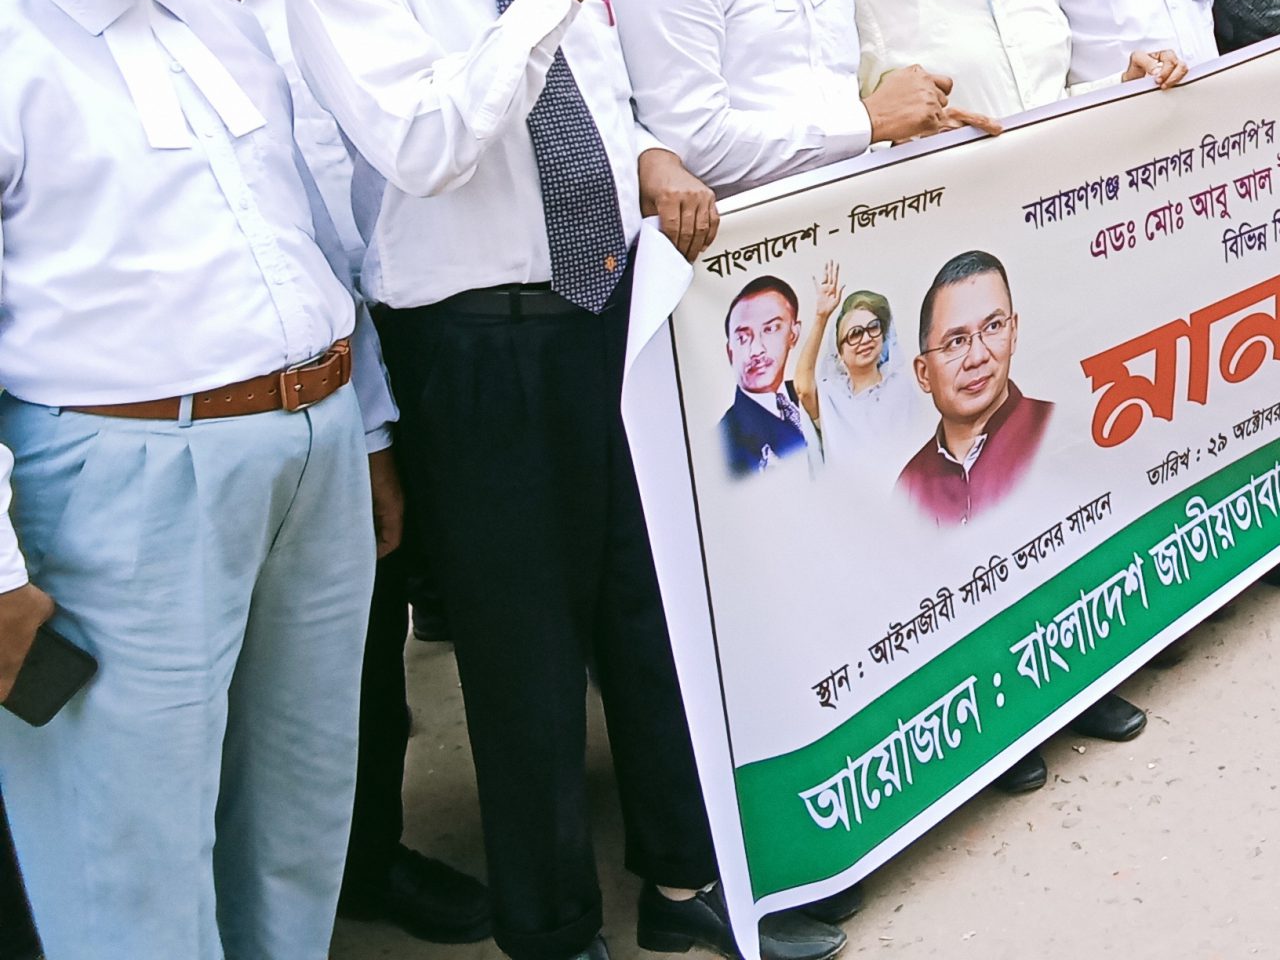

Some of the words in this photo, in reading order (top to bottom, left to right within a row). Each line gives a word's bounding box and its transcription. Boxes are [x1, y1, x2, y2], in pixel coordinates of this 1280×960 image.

[703, 222, 819, 279] বাংলাদেশ
[848, 183, 946, 236] জিন্দাবাদ
[1022, 174, 1120, 230] নারায়ণগঞ্জ
[1126, 147, 1195, 193] মহানগর
[1090, 219, 1137, 259] এডঃ
[1145, 200, 1185, 242] মোঃ
[1189, 182, 1232, 221] আবু
[1233, 166, 1273, 203] আল
[1221, 222, 1268, 264] বিভিন্ন
[1145, 447, 1190, 488] তারিখ
[1206, 431, 1229, 458] ২৯
[811, 662, 853, 709] স্থান
[868, 588, 956, 666] আইনজীবী
[958, 555, 1010, 607] সমিতি
[1012, 521, 1066, 571] ভবনের
[1066, 491, 1112, 536] সামনে
[797, 674, 983, 833] আয়োজনে
[1010, 551, 1150, 691] বাংলাদেশ
